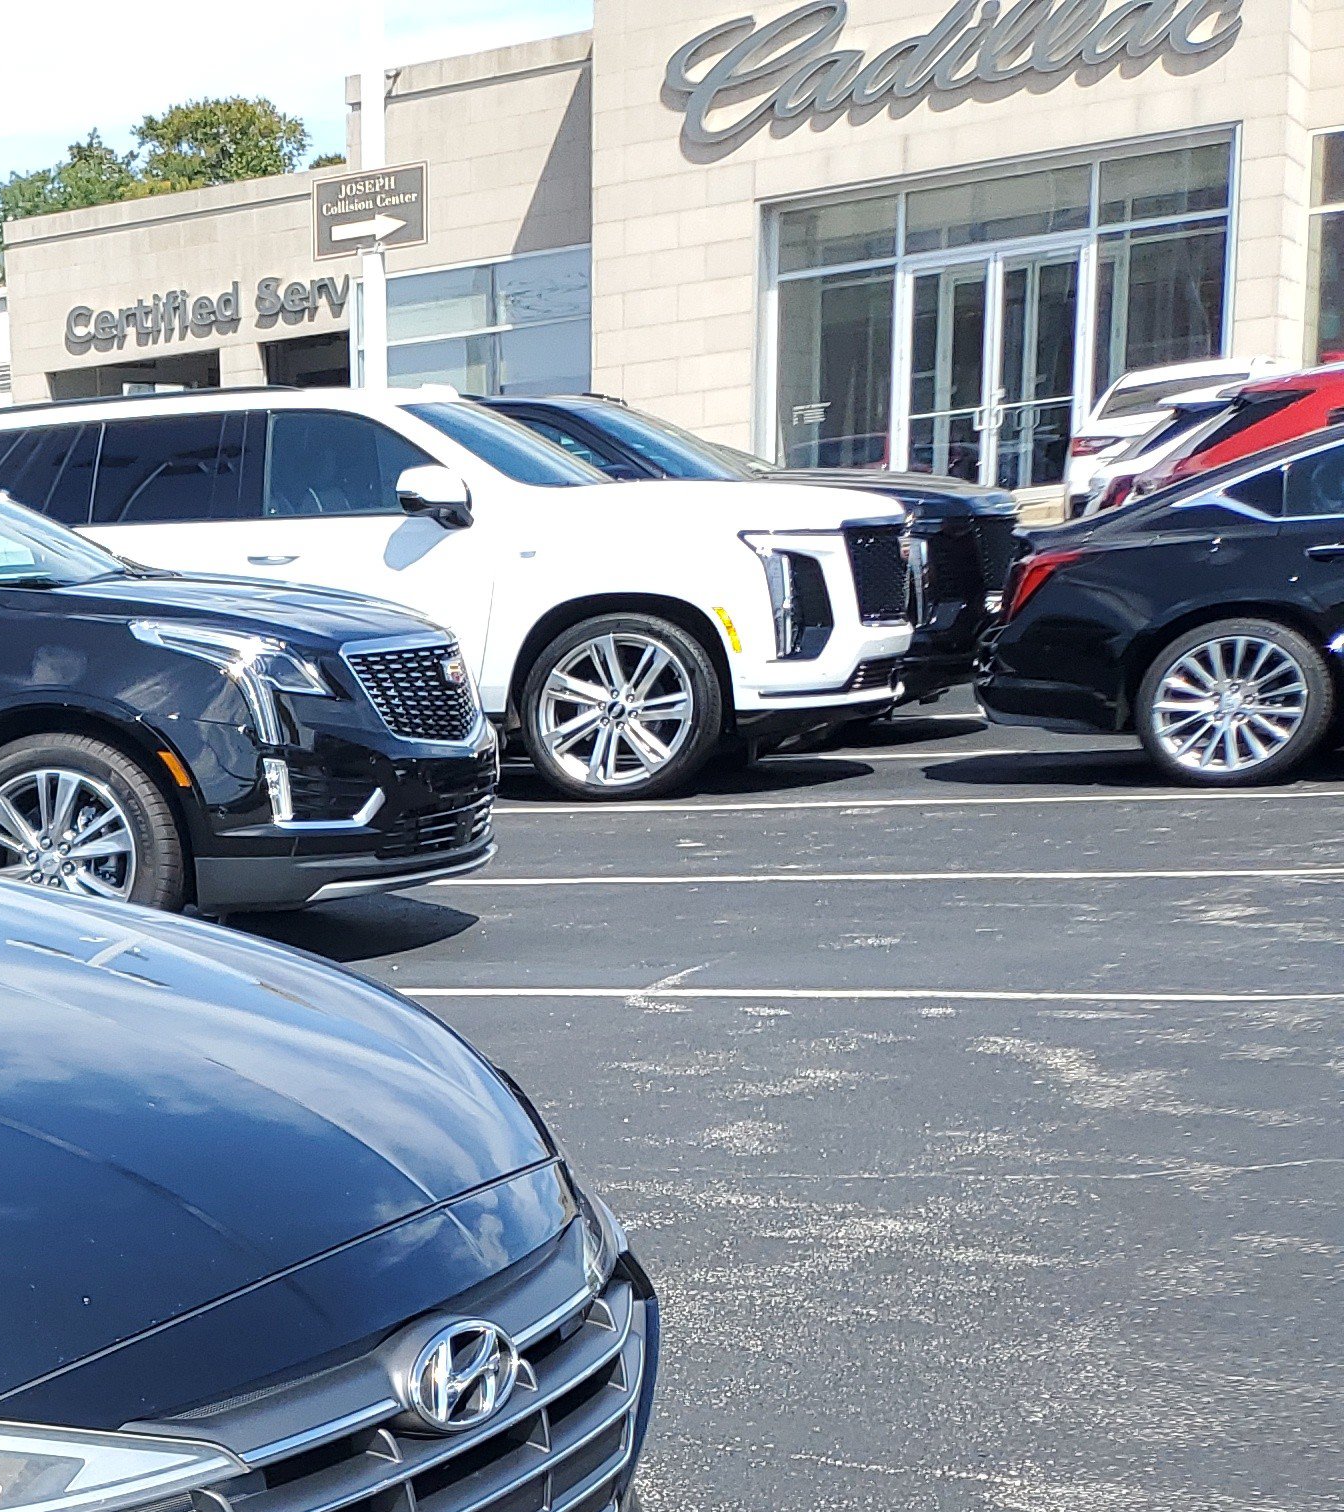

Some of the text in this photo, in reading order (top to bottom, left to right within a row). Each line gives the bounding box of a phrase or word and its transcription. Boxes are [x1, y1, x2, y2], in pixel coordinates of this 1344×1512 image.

[338, 175, 396, 199] JOSEPH
[322, 192, 418, 217] Collision Center
[65, 280, 240, 343] Certified
